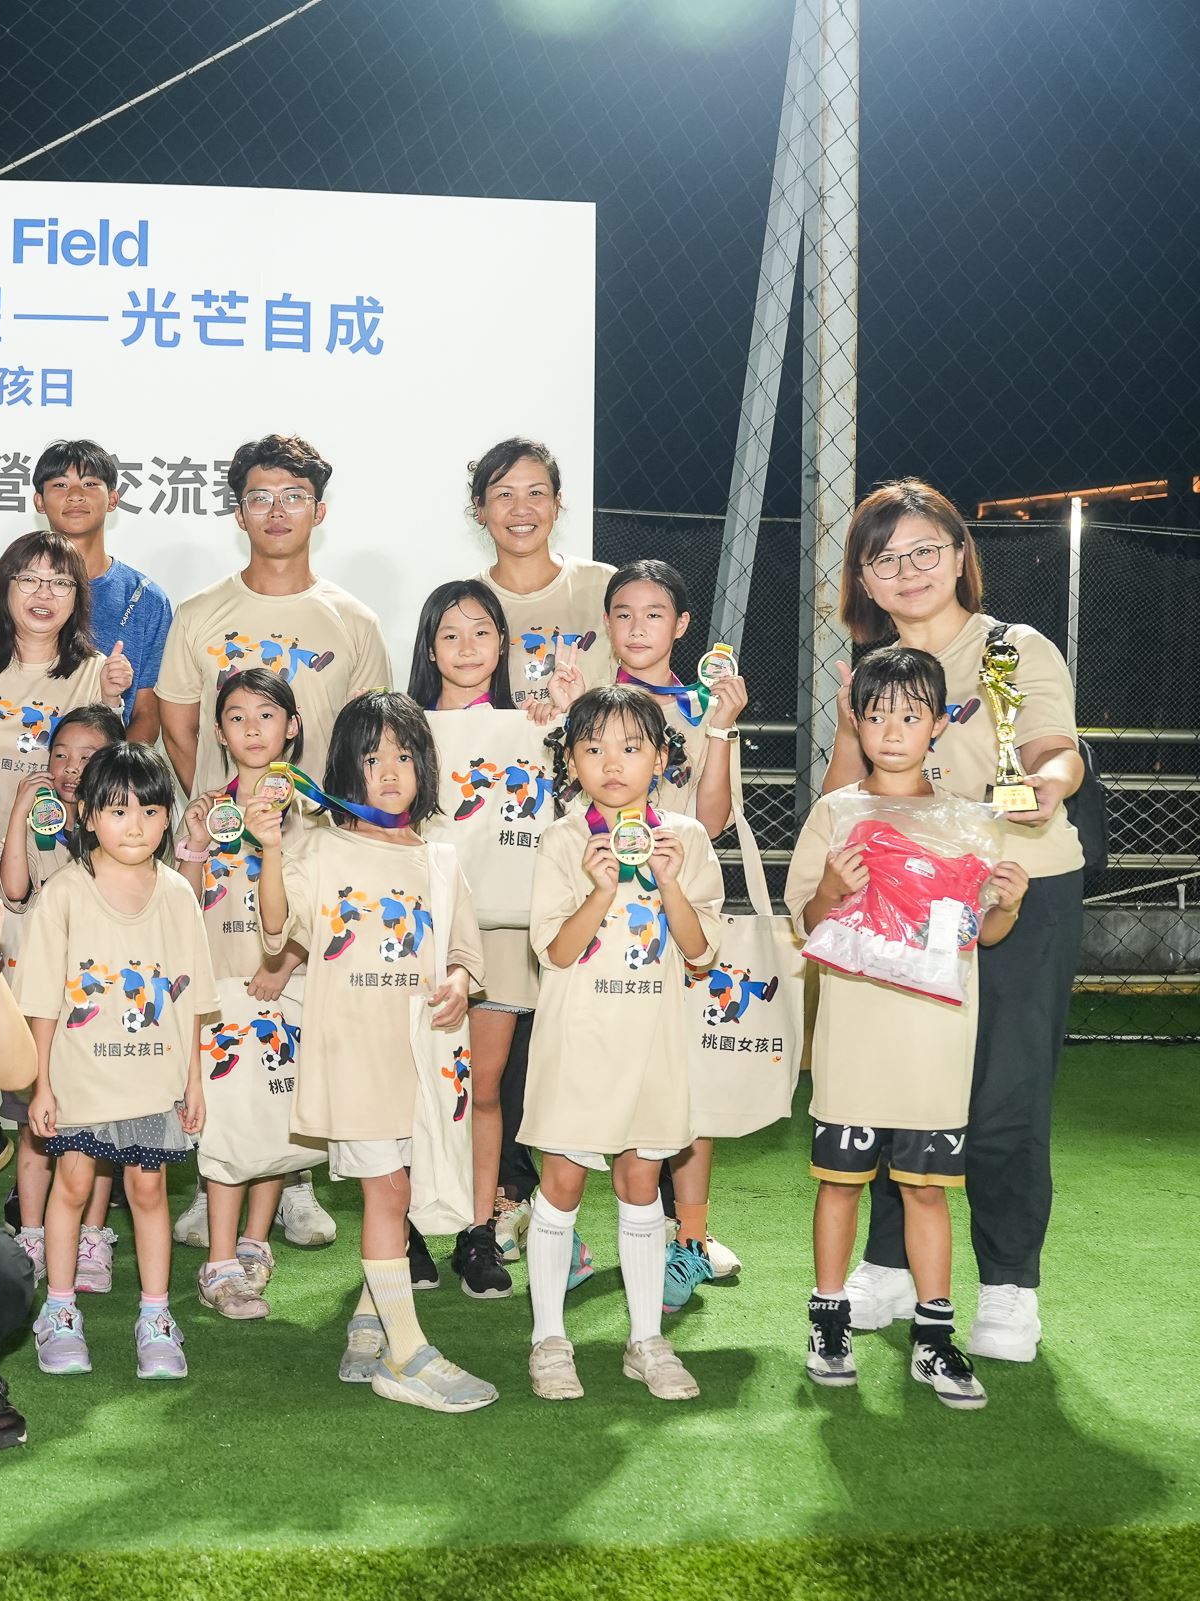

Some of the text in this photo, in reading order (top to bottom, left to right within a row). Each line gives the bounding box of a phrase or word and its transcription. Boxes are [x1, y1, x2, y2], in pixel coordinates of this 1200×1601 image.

[12, 217, 149, 268] Field
[120, 604, 135, 627] KAPPA
[511, 688, 550, 703] 園女孩
[222, 920, 260, 934] 桃園女
[349, 972, 420, 987] 桃園女孩日
[594, 978, 663, 994] 桃園女孩日
[93, 1042, 164, 1057] 桃園女孩日
[701, 1033, 783, 1053] 桃園女孩日
[808, 1300, 841, 1311] onti
